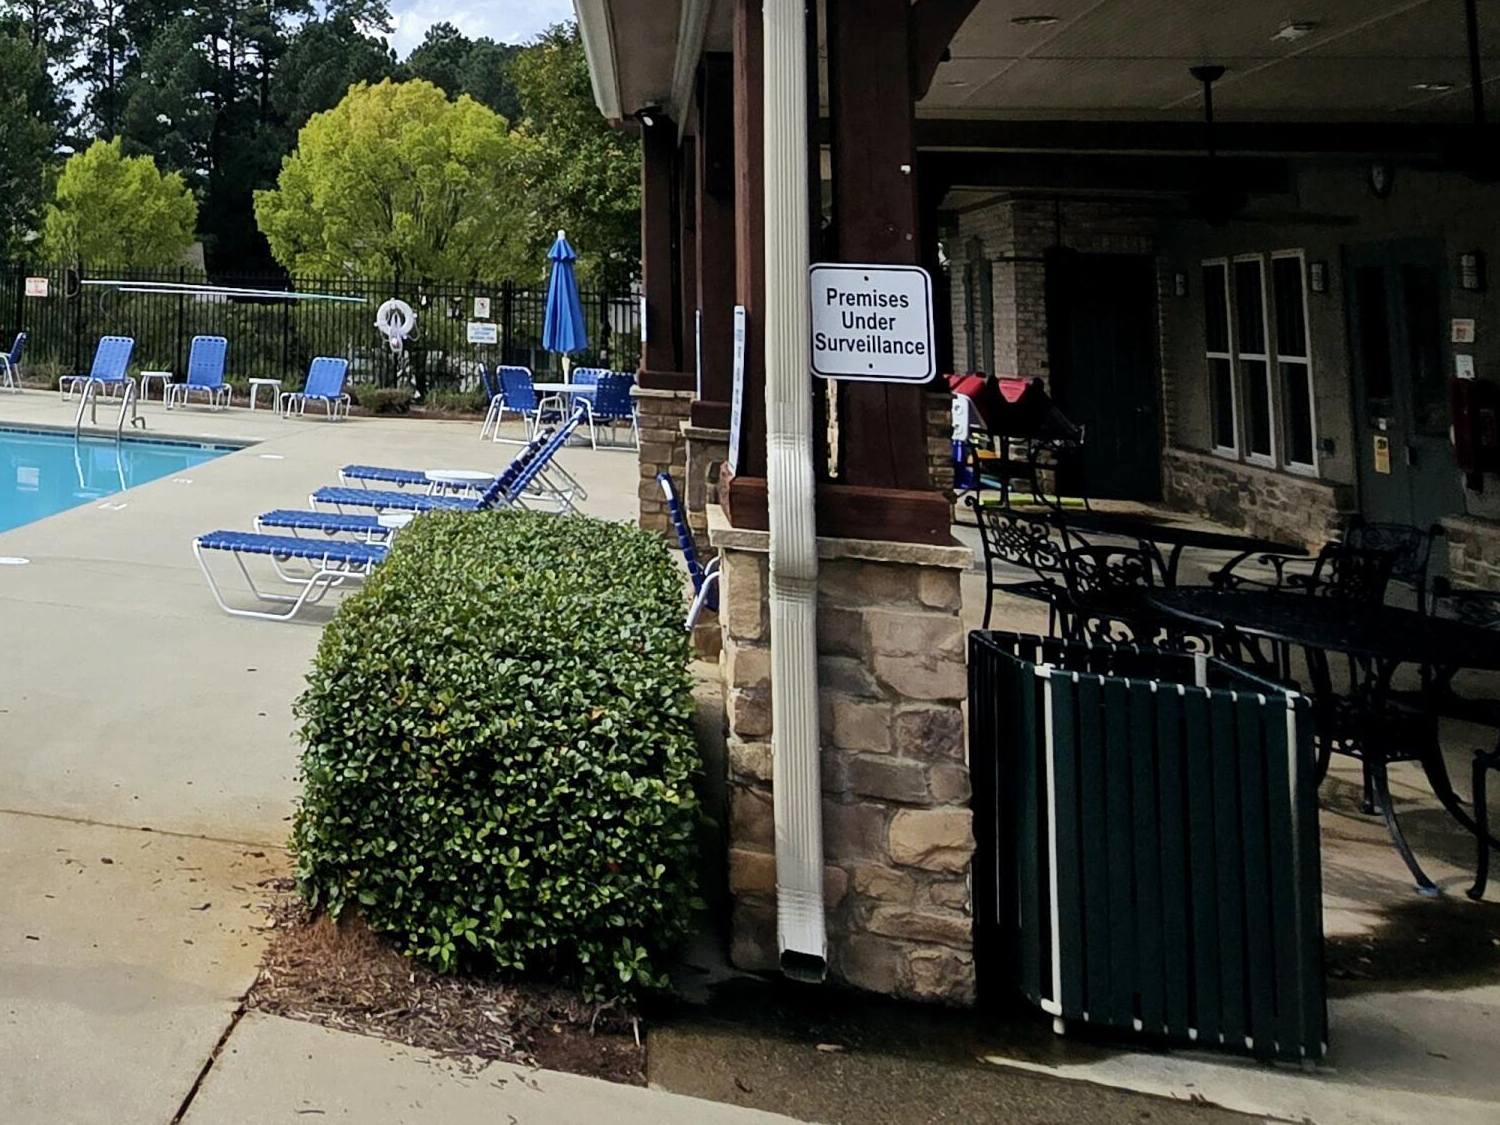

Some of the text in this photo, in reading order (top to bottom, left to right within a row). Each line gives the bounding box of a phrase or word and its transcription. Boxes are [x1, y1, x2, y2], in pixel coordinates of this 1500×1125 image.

[826, 287, 909, 308] Premises
[841, 311, 896, 330] Under
[815, 332, 925, 355] Surveillance
